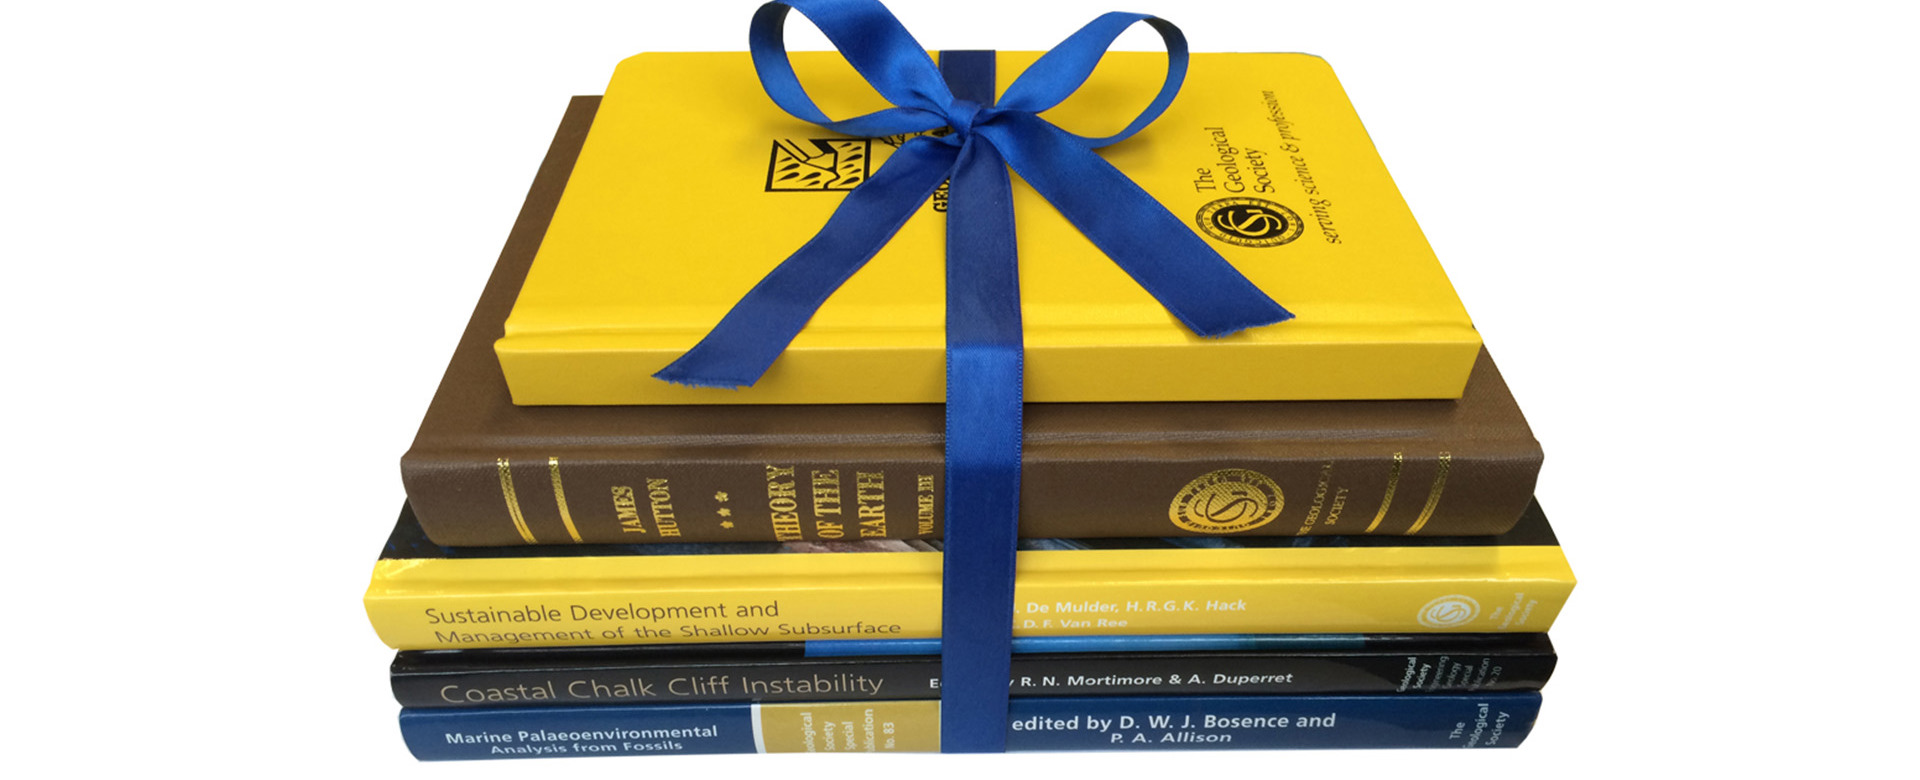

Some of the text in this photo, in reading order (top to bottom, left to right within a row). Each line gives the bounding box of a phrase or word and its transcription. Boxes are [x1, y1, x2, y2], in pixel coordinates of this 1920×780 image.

[1204, 127, 1245, 193] Geological
[1280, 143, 1300, 154] &
[1193, 167, 1217, 193] The
[1245, 147, 1275, 193] Society
[1290, 155, 1320, 195] science
[1309, 199, 1342, 245] serving
[611, 485, 646, 534] JAMES
[646, 477, 681, 537] HUTTON
[766, 464, 803, 541] THEORY
[811, 469, 844, 539] OF THE
[856, 470, 887, 538] EARTH
[917, 495, 934, 535] VOLUME
[1325, 487, 1349, 525] SOCIETY
[425, 600, 779, 625] Sustainable Development and
[1026, 602, 1049, 613] De
[1055, 601, 1119, 614] Mulder,
[1205, 599, 1247, 611] Hack
[434, 621, 901, 644] Management of the Shallow Subsurface
[1060, 619, 1091, 628] Van
[1097, 619, 1128, 627] Ree
[1021, 676, 1036, 687] R.
[1042, 676, 1060, 687] N.
[1067, 675, 1162, 686] Mortimore
[1168, 674, 1182, 685] &
[1187, 674, 1206, 685] A.
[1213, 673, 1294, 686] Duperret
[1412, 663, 1432, 689] Society
[1491, 666, 1502, 676] 20
[440, 674, 884, 704] Coastal Chalk Cliff Instability
[445, 725, 718, 745] Marine Palaeoenvironmental
[824, 721, 836, 750] Society
[842, 721, 858, 750] Special
[883, 722, 895, 735] 83
[1012, 713, 1336, 732] edited by D. W. J. Bosence and
[1449, 722, 1466, 740] The
[1463, 703, 1489, 748] eological
[1485, 711, 1510, 745] Society
[491, 740, 683, 755] Analysis from Fossils
[1110, 732, 1232, 743] P. A. Allison
